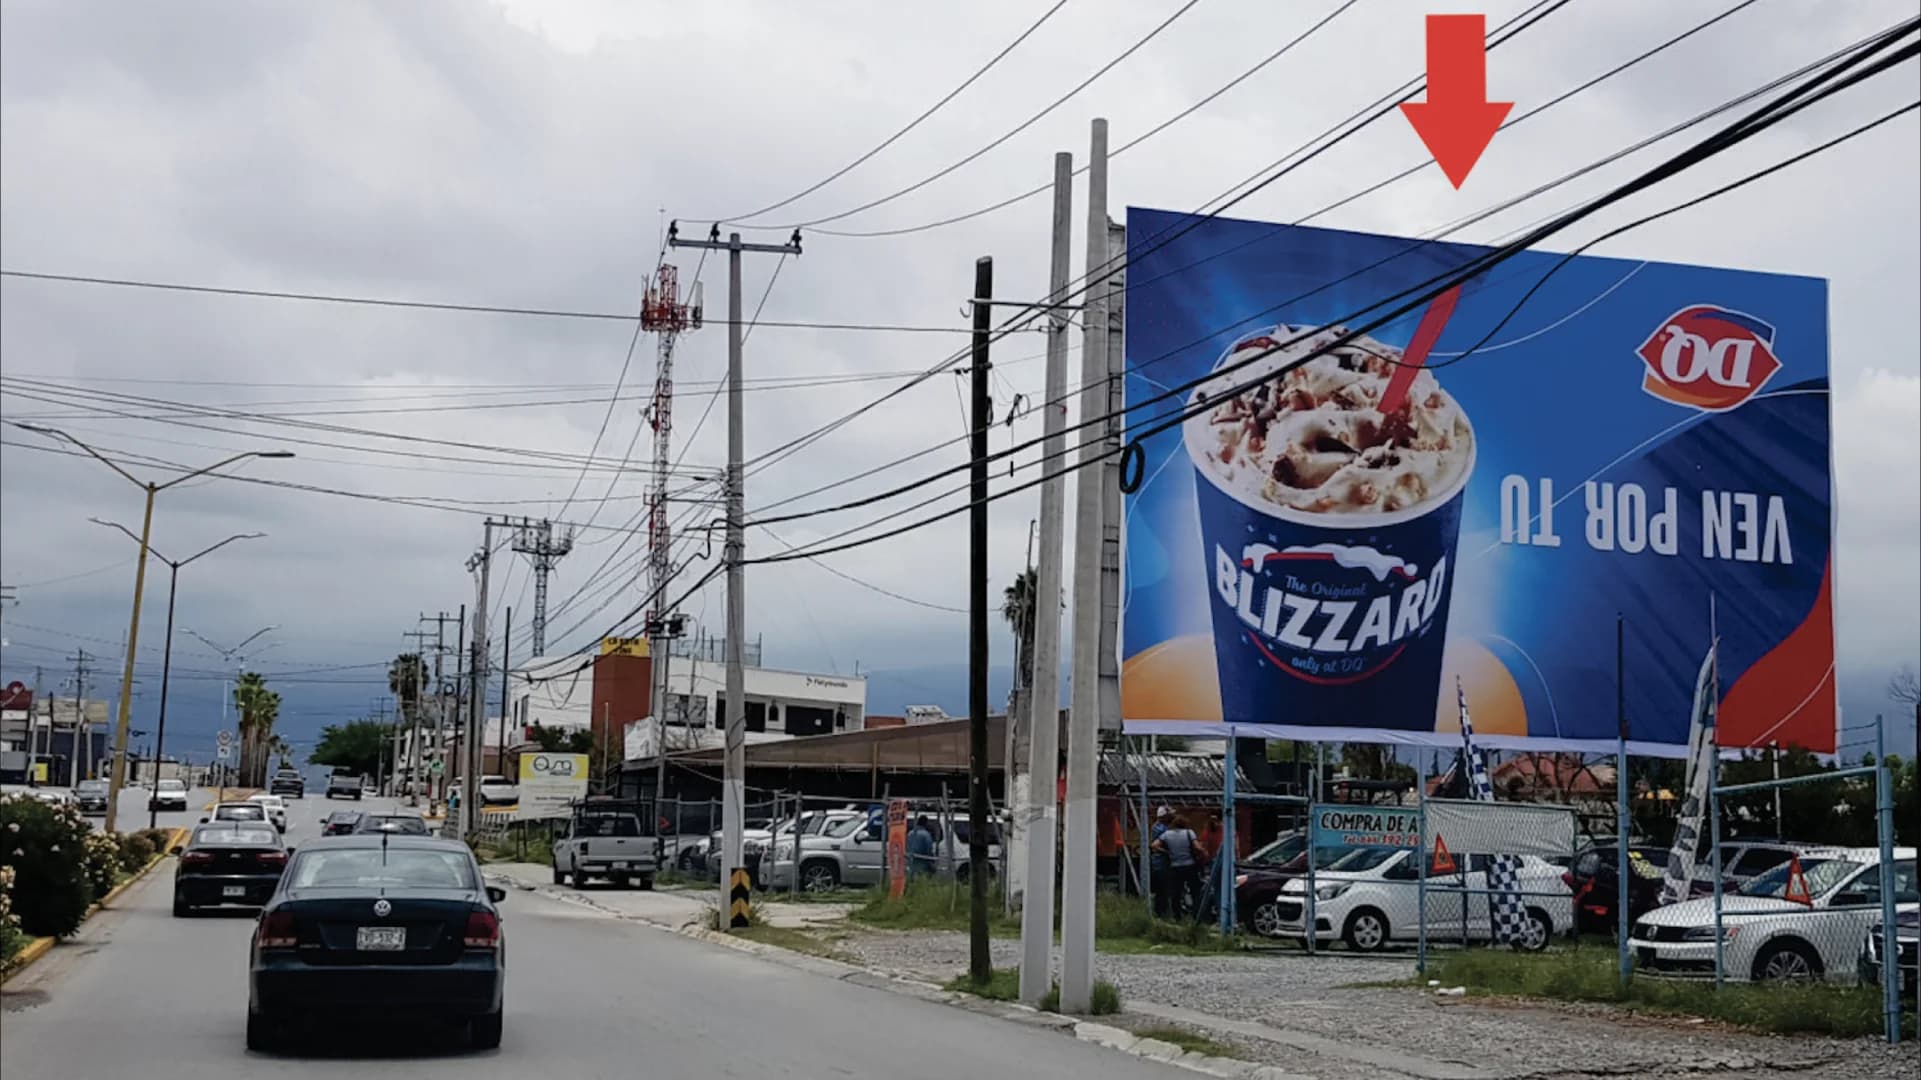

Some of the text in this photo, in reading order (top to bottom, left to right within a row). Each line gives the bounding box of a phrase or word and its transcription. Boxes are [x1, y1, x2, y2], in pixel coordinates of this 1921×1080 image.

[1660, 325, 1756, 389] DQ
[1500, 474, 1793, 564] VEN POR TU
[1216, 543, 1447, 653] BLIZZARD
[1285, 575, 1367, 598] The Original
[1291, 656, 1364, 674] only at DQ
[1321, 812, 1382, 832] COMPRA
[1387, 815, 1404, 832] DE
